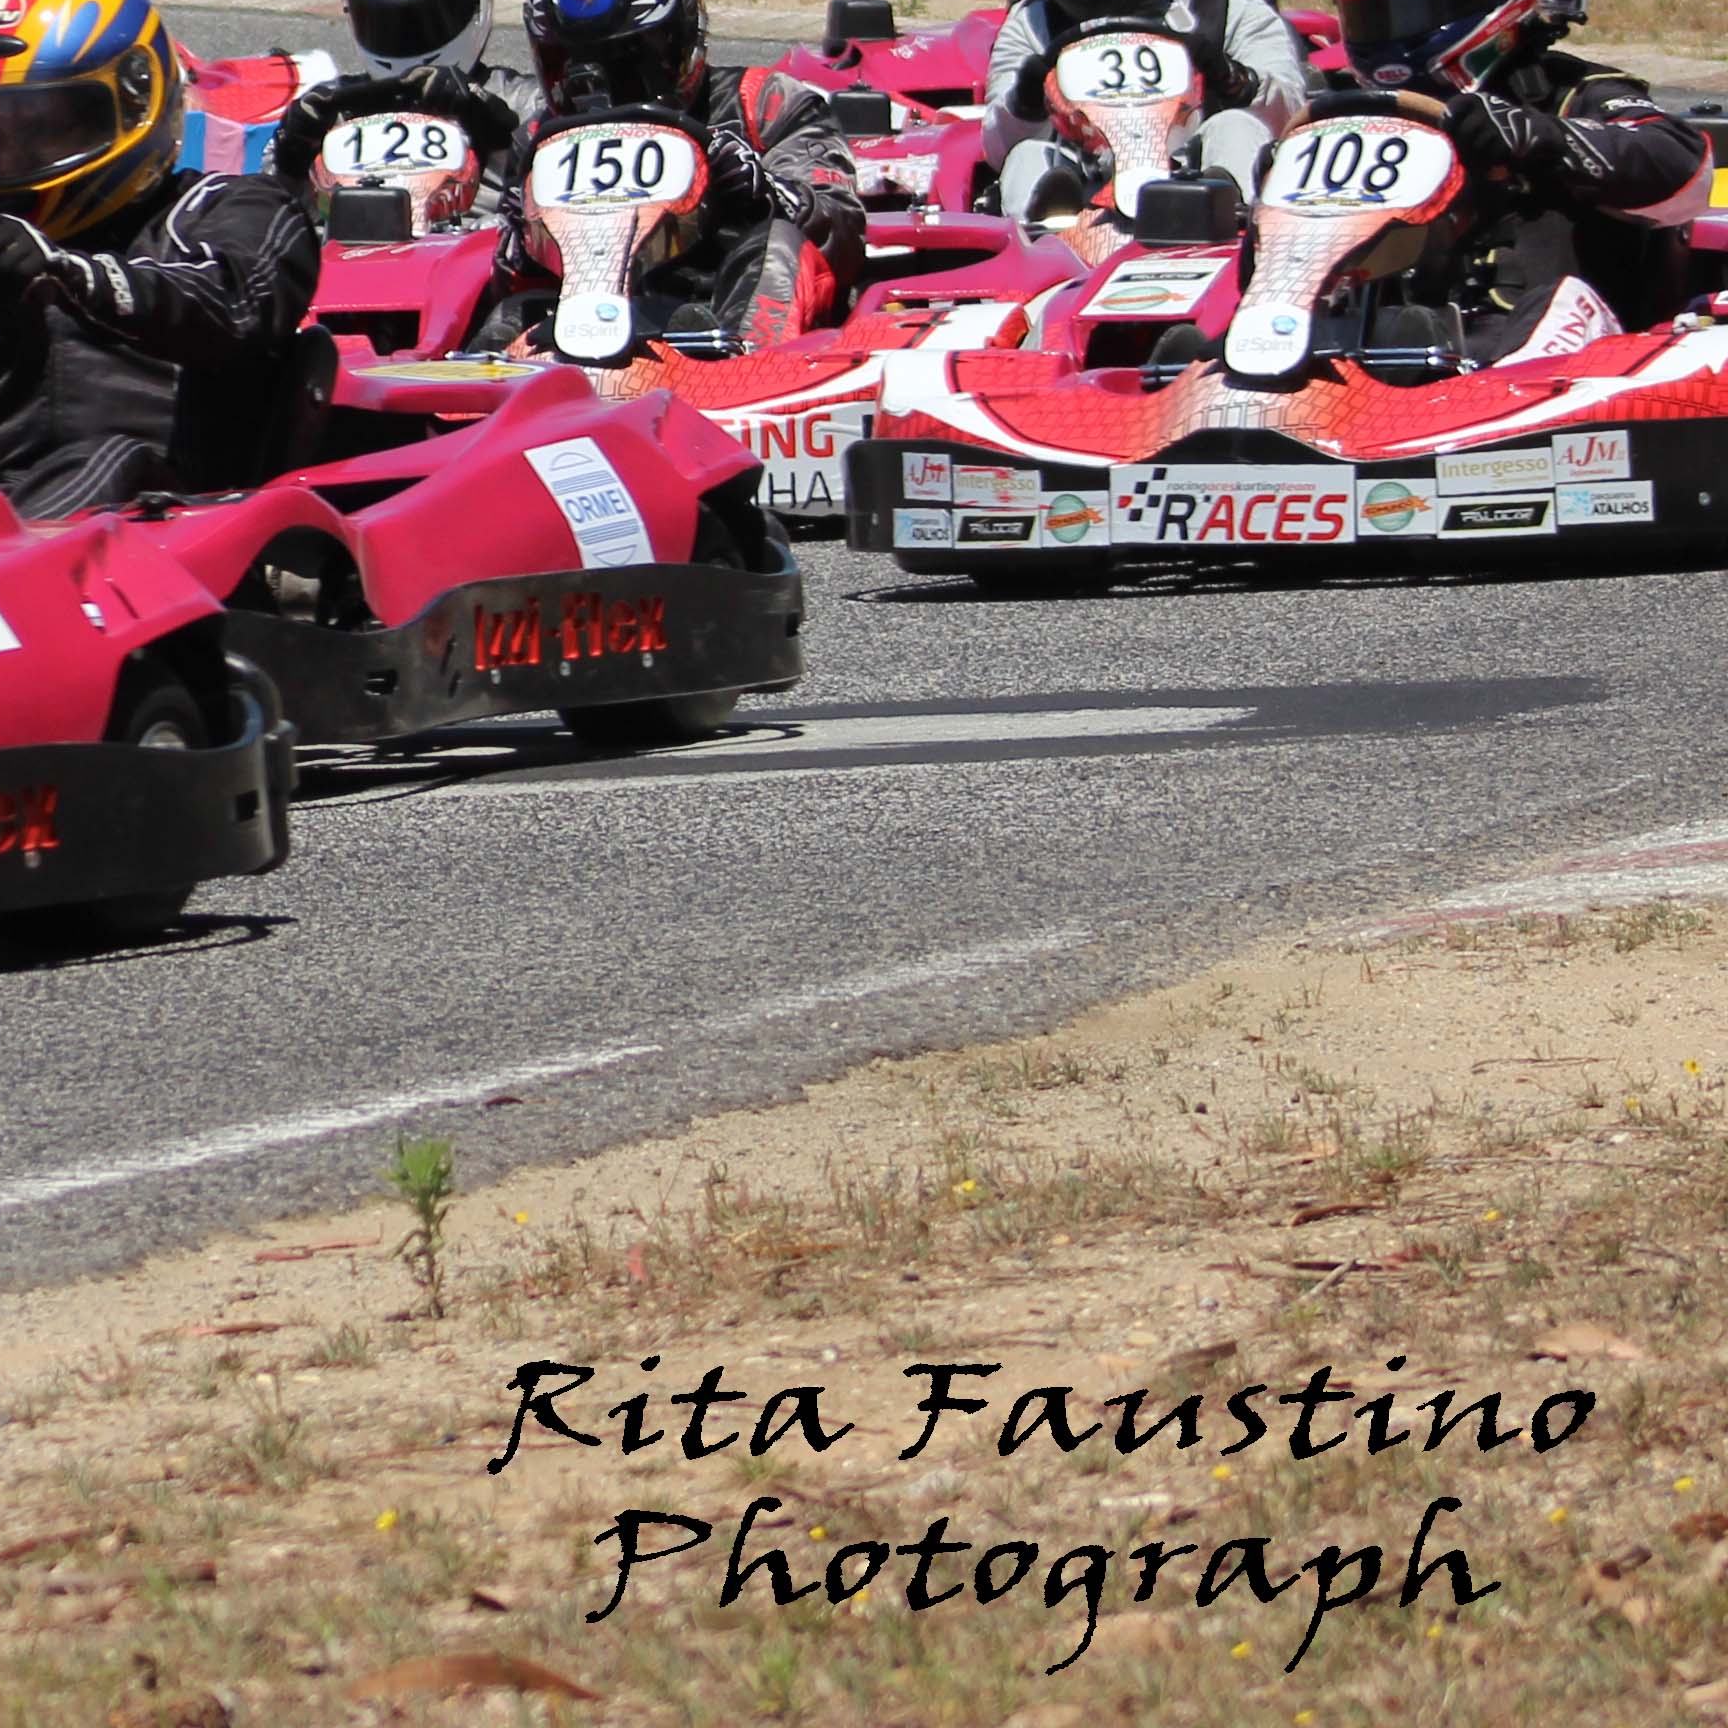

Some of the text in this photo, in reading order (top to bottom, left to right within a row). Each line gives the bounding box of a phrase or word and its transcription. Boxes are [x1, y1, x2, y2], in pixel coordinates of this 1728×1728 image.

[1099, 45, 1162, 89] 39
[344, 122, 448, 164] 128
[558, 139, 664, 191] 150
[1296, 133, 1408, 192] 108
